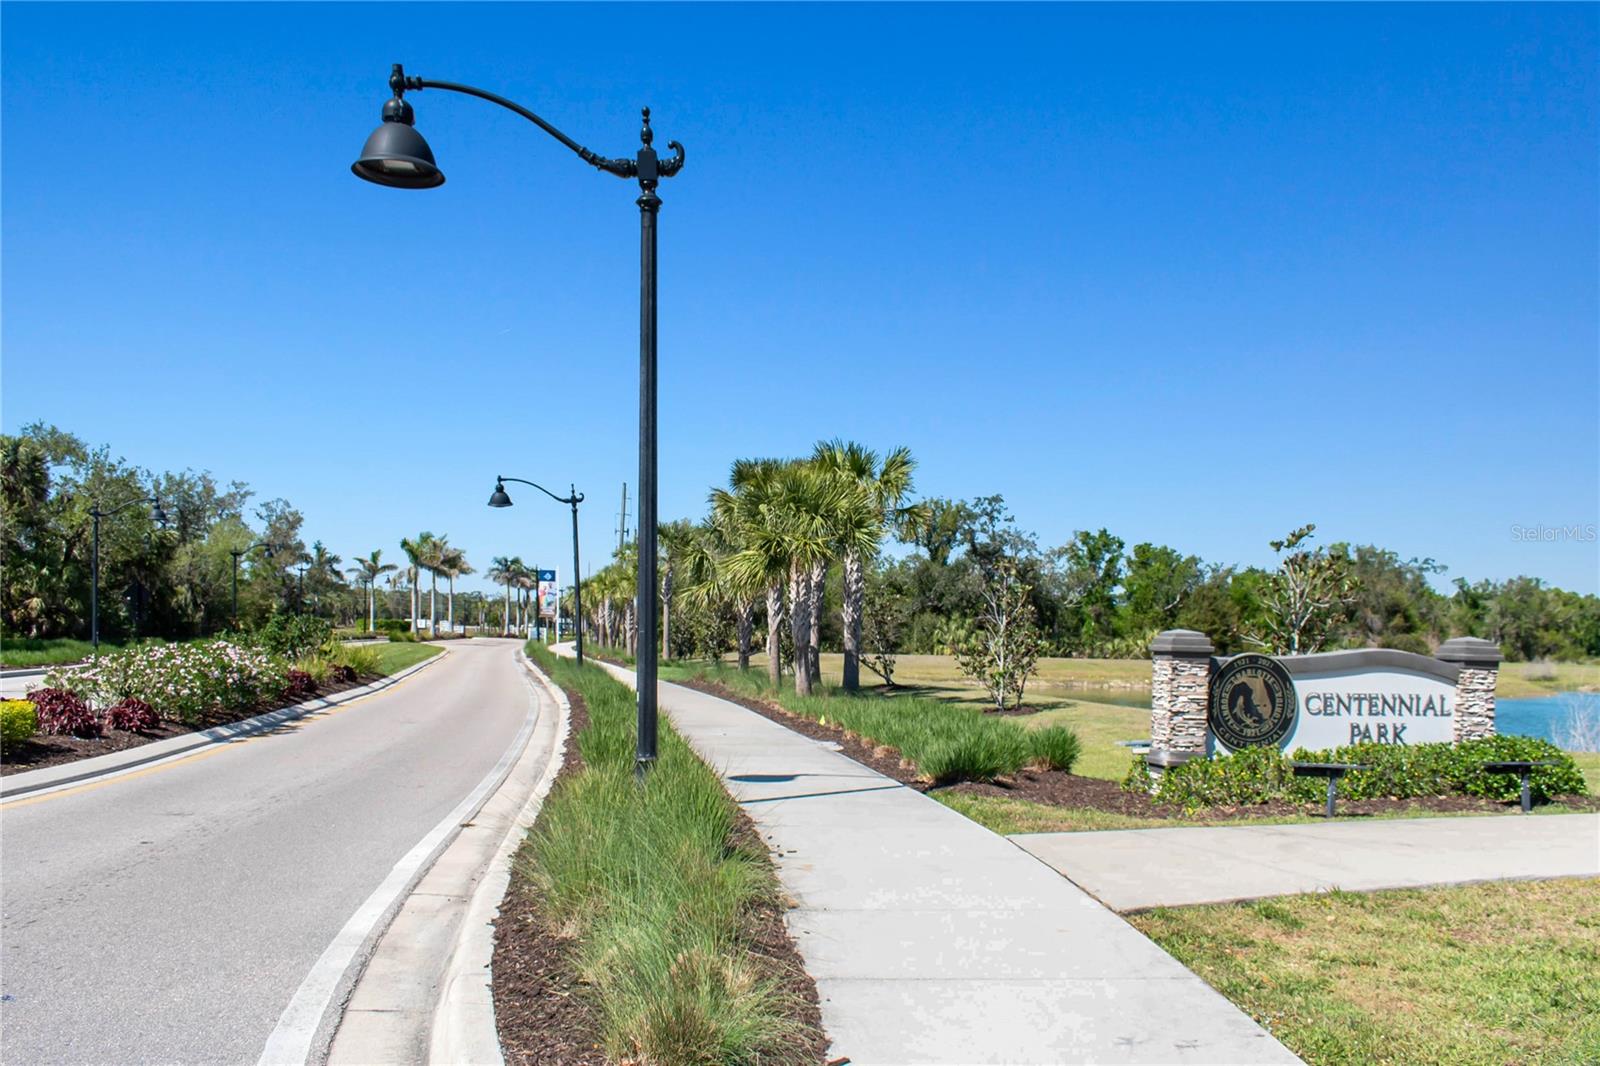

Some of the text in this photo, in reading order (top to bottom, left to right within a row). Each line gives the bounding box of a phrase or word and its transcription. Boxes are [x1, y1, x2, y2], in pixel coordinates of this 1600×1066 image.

[1257, 657, 1274, 668] 2021
[1305, 692, 1452, 717] CENTENNIAL
[1350, 722, 1408, 745] PARK
